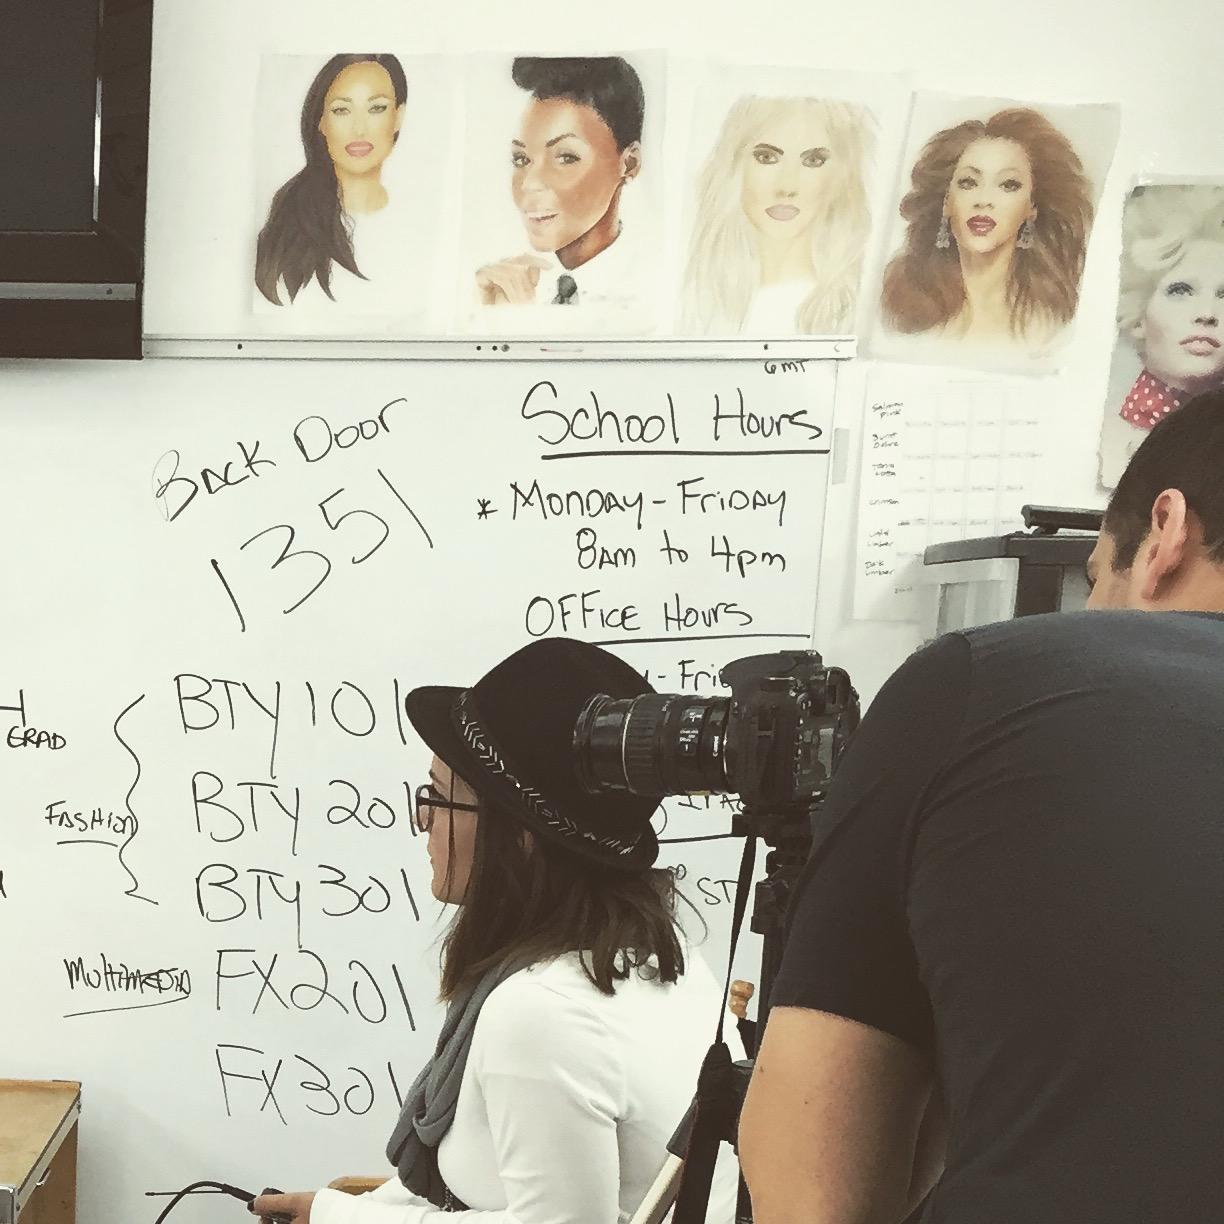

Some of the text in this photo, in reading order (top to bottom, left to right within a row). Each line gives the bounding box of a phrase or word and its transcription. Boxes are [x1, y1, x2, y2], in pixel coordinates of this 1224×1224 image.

[521, 381, 824, 447] School Hours
[210, 468, 434, 632] 1351
[660, 530, 689, 565] to
[6, 726, 66, 751] GRAD
[326, 779, 417, 836] 201
[318, 864, 419, 922] 301
